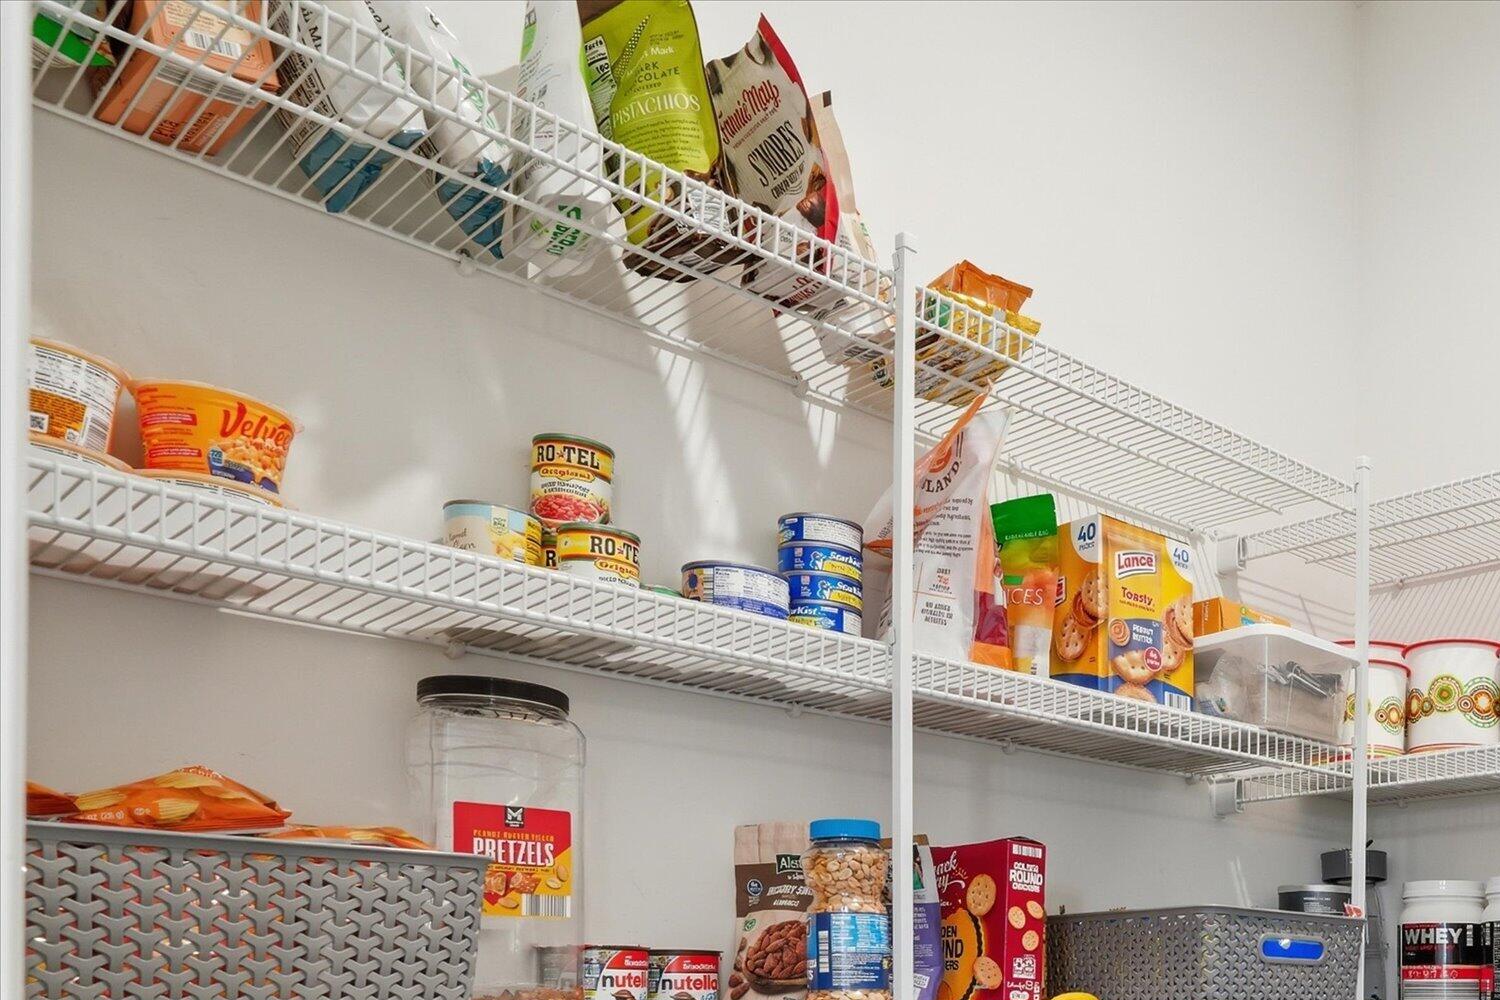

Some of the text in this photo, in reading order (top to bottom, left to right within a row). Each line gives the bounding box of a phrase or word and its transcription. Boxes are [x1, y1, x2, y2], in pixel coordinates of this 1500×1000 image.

[742, 79, 782, 114] May
[612, 92, 701, 129] PISTACHIOS
[747, 120, 805, 188] S'MORES
[1078, 523, 1096, 542] 40
[1117, 554, 1154, 570] Lance
[1173, 548, 1189, 563] 40
[1121, 586, 1154, 606] Toasty
[472, 837, 555, 867] PRETZELS
[1009, 869, 1043, 886] ROUND
[1404, 927, 1463, 946] WHEY
